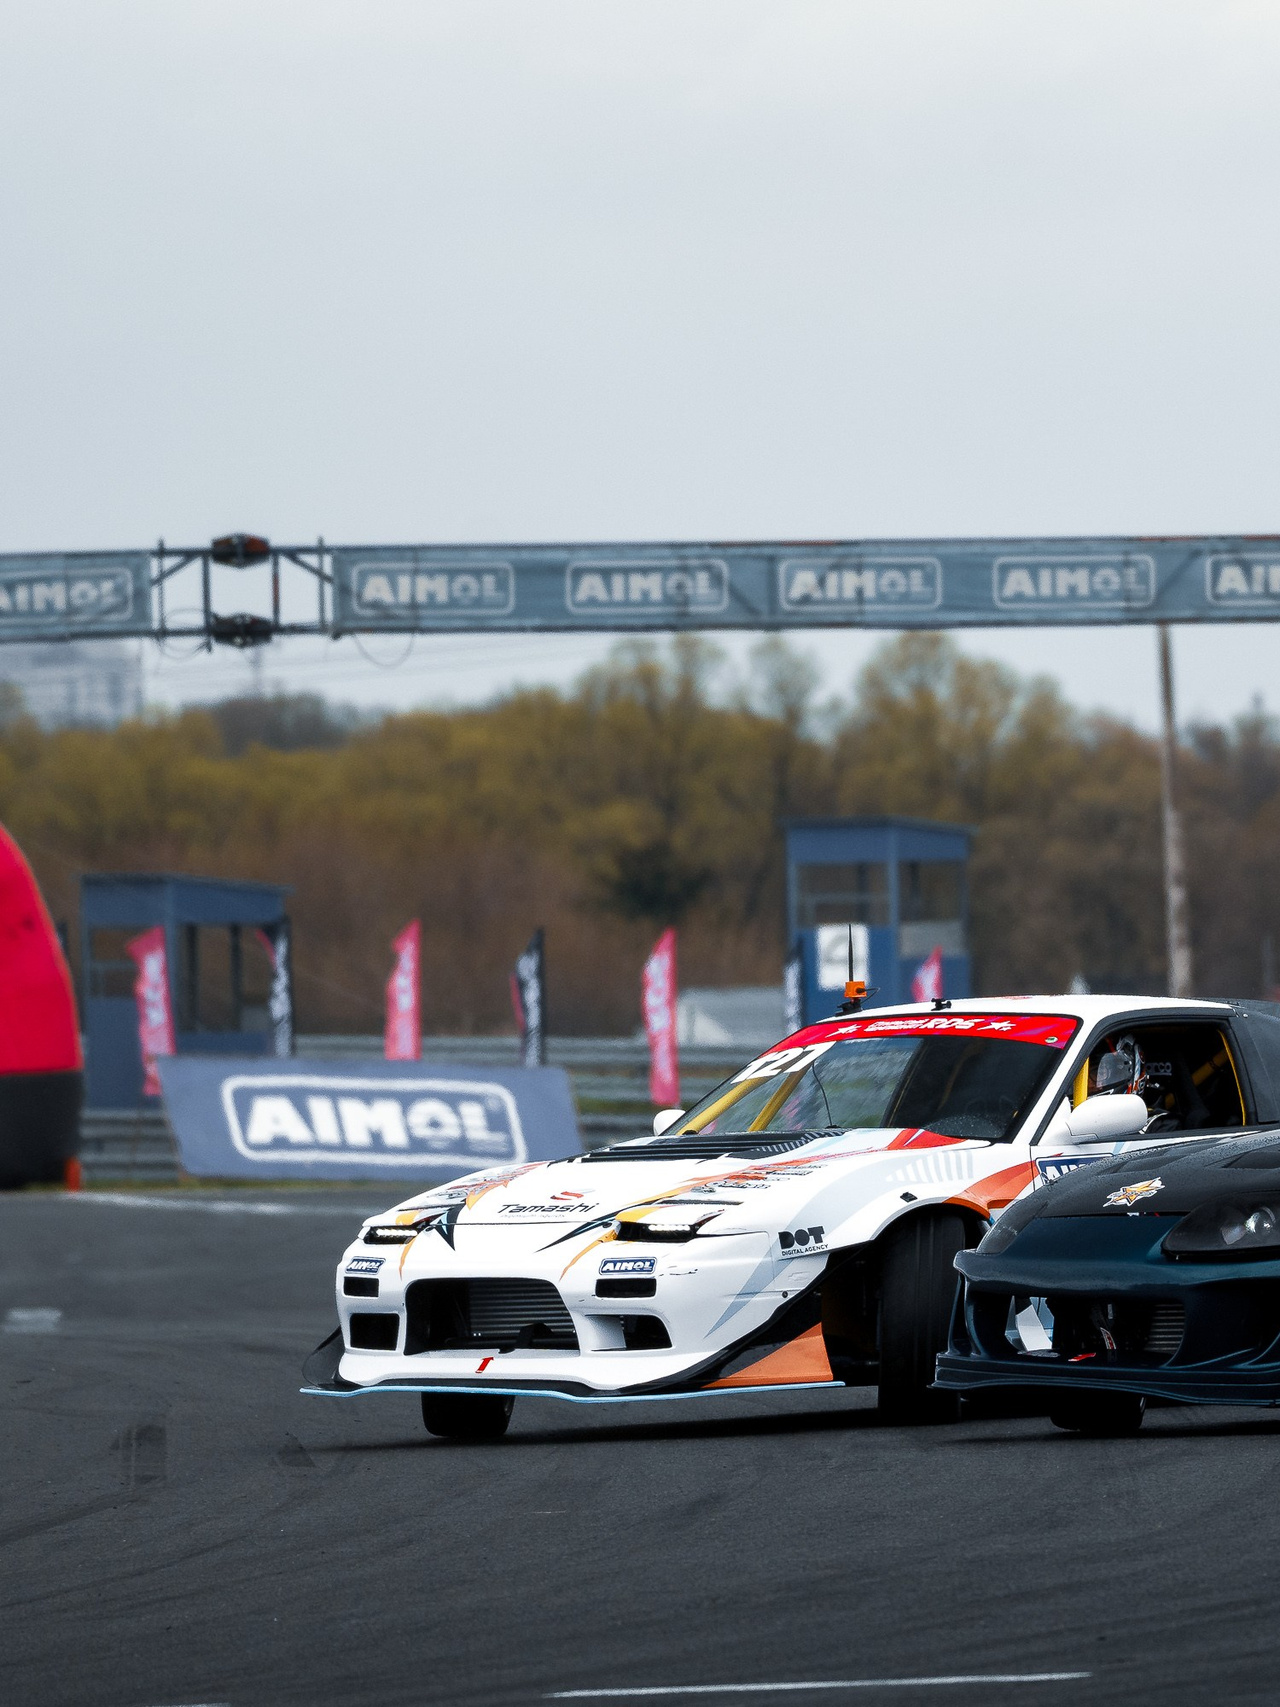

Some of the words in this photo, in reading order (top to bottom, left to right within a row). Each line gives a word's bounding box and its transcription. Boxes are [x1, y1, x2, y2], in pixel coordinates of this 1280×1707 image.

[361, 574, 504, 604] AIMOL
[575, 571, 718, 602] AIMOL
[789, 568, 932, 600] AIMOL
[1002, 567, 1146, 597] AIMOL
[730, 1040, 837, 1085] 127
[248, 1095, 508, 1151] AIMOL
[497, 1202, 600, 1214] Tamashi
[778, 1226, 825, 1249] DOT
[781, 1248, 804, 1256] DIGITAL
[804, 1244, 829, 1254] AGENCY
[347, 1259, 384, 1270] AIMOL
[602, 1260, 654, 1272] AIMOL
